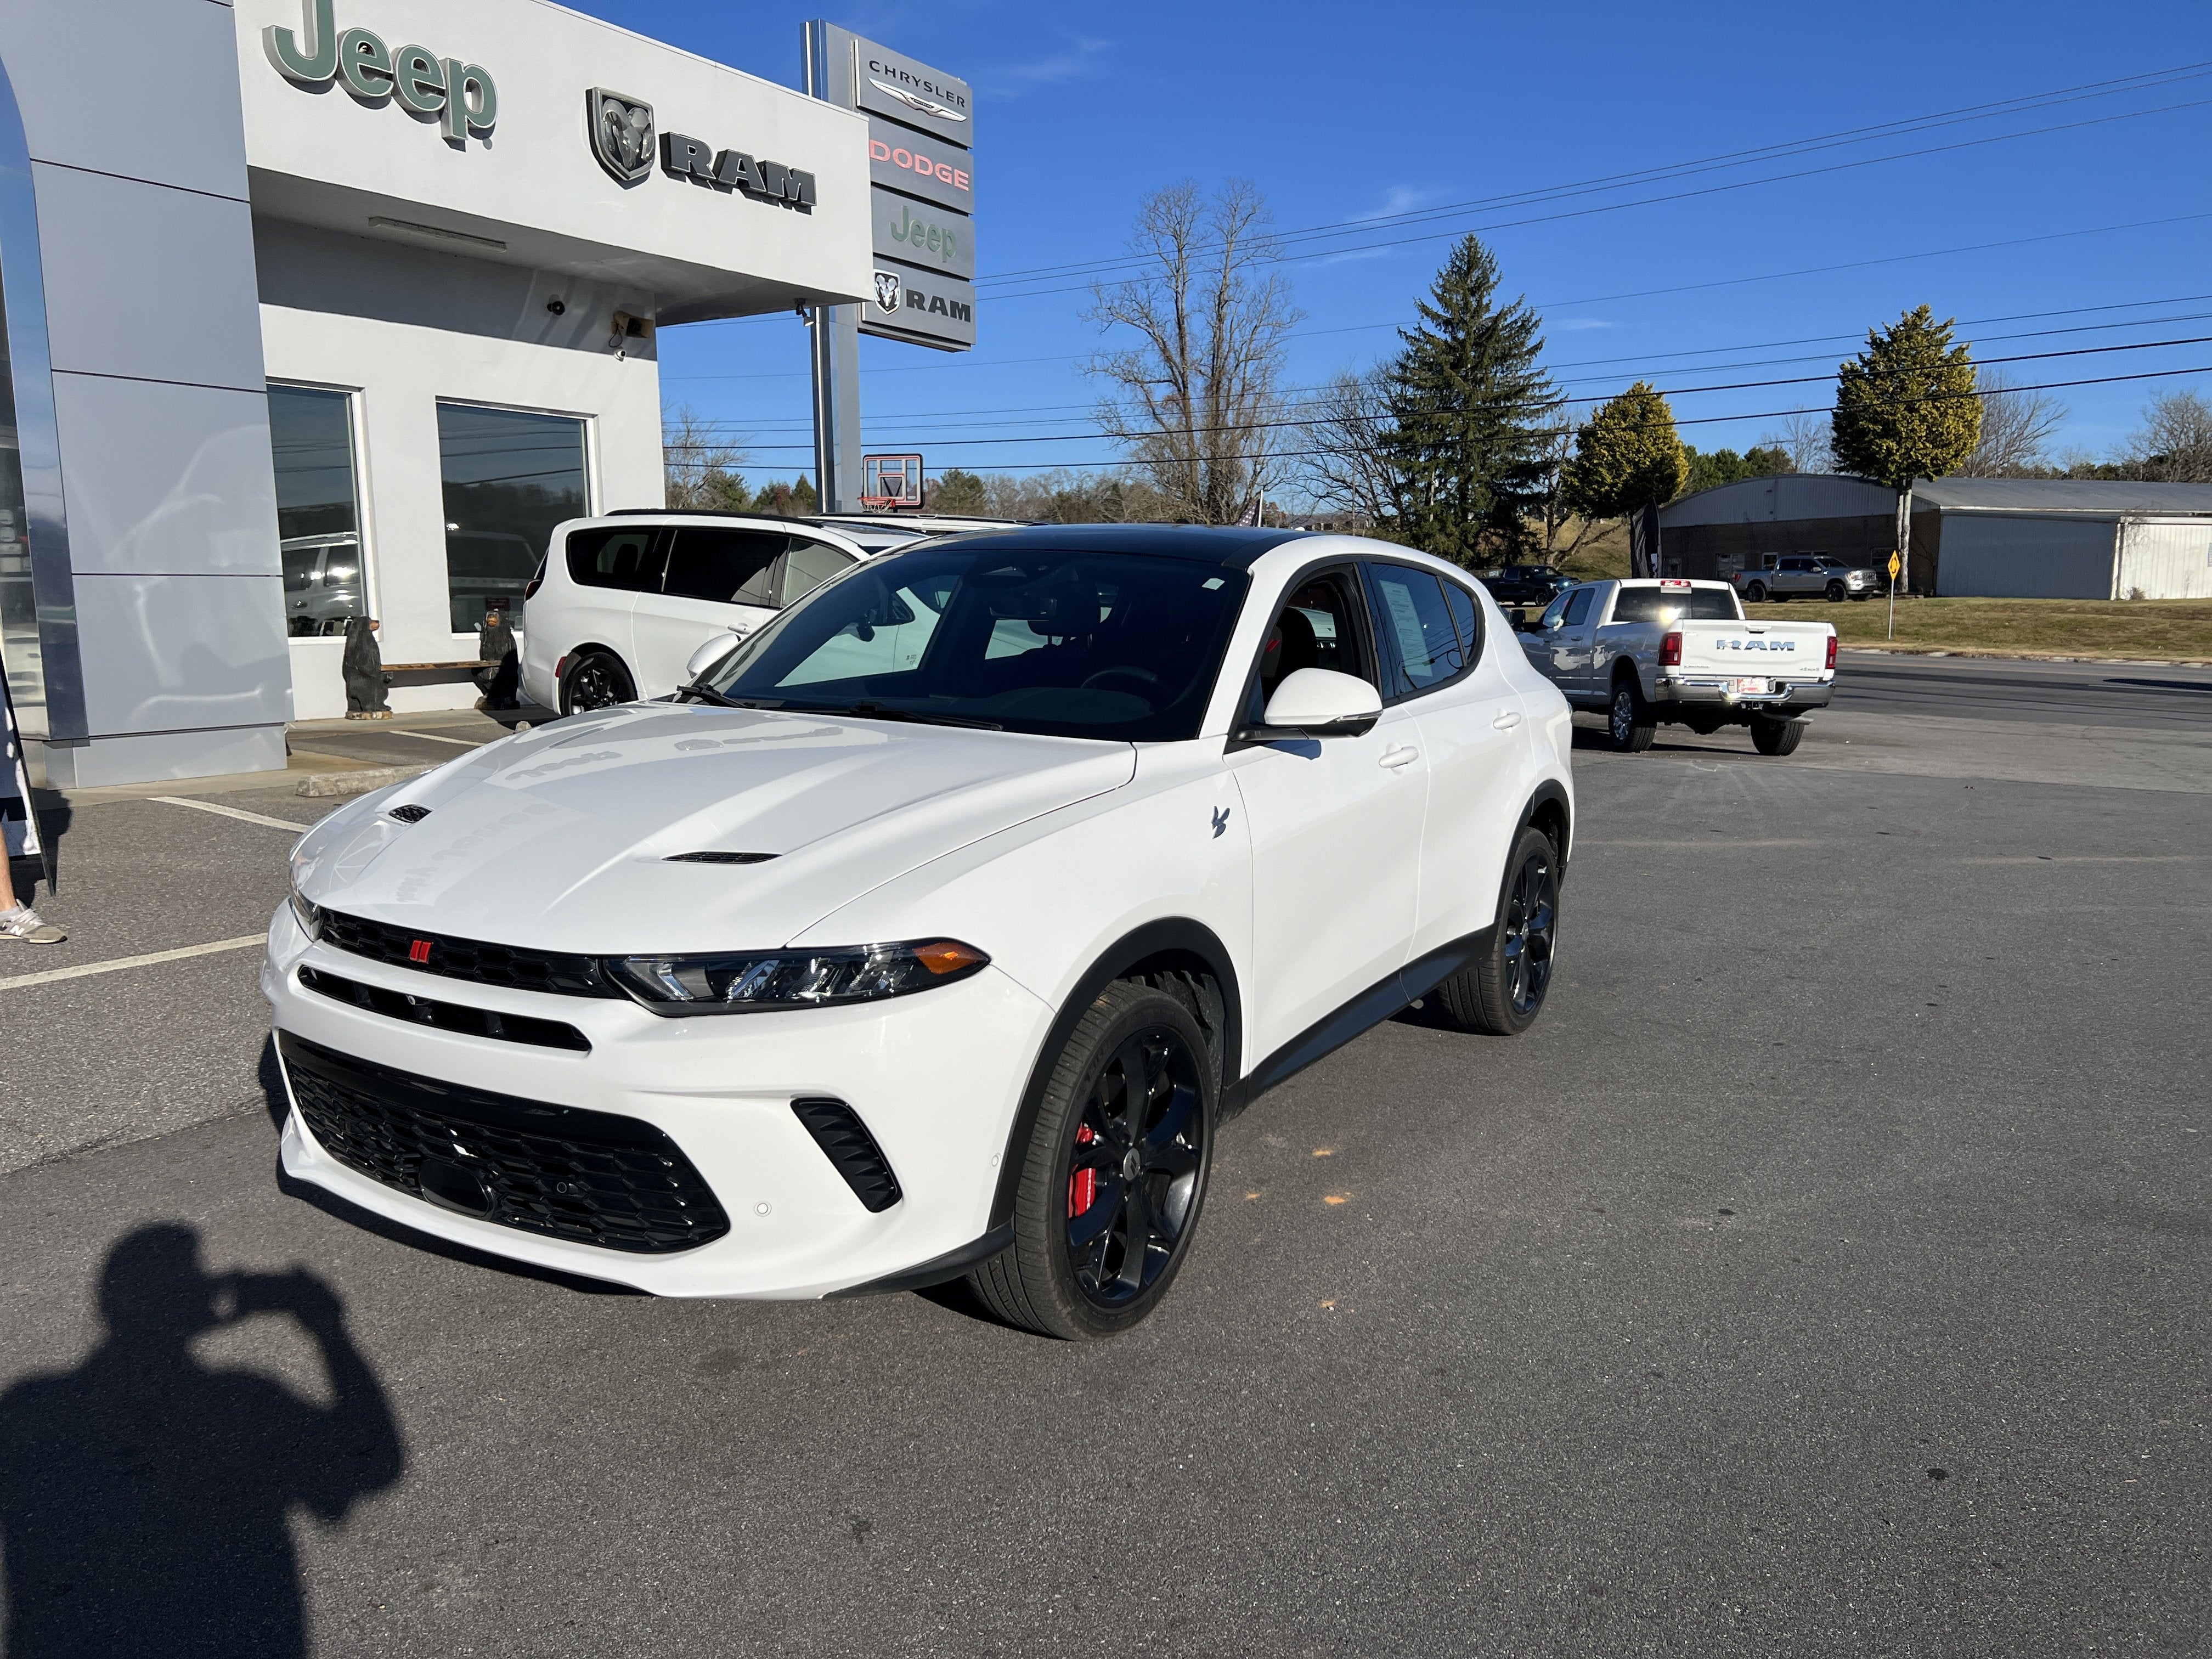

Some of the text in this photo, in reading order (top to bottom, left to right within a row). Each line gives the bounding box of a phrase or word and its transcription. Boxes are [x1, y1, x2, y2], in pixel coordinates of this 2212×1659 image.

[262, 0, 499, 140] Jeep
[868, 60, 966, 108] CHRYSLER
[659, 131, 817, 207] RAM
[869, 139, 970, 191] DODGE
[890, 205, 957, 263] Jeep
[906, 288, 971, 323] RAM
[1716, 640, 1795, 651] RAM
